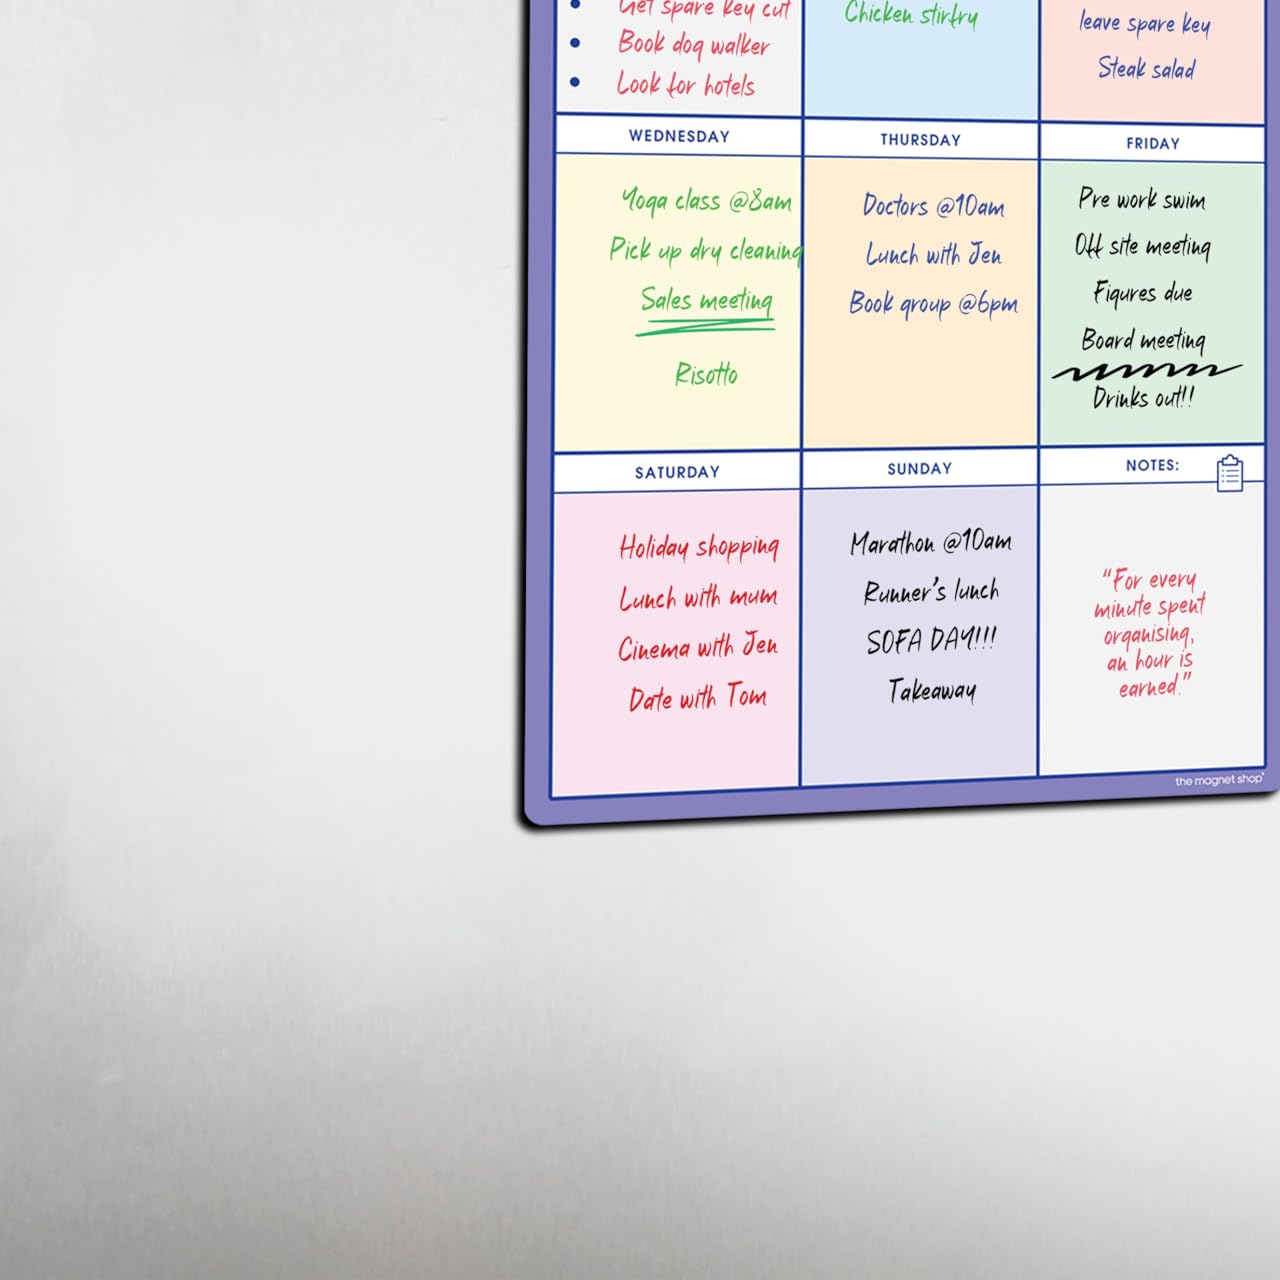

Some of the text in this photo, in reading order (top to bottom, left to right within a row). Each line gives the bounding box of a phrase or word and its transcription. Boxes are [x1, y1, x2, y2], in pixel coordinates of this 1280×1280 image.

[919, 2, 979, 33] stirfry
[1079, 8, 1212, 40] leave spare key
[618, 28, 772, 64] Book dog walker
[1098, 55, 1197, 81] Steak salad
[616, 69, 756, 99] Look for hotels
[628, 129, 730, 143] WEDNESDAY
[880, 133, 961, 147] THURSDAY
[1126, 137, 1180, 150] FRIDAY
[622, 185, 792, 219] Yoga class @8am
[863, 191, 1005, 219] Doctors @10am
[1078, 185, 1206, 210] Pre work swim
[609, 235, 805, 269] Pick up dry cleaning
[866, 240, 1002, 266] Lunch with Jen
[1075, 232, 1212, 264] Off site meeting
[641, 286, 773, 318] Sales meeting
[849, 289, 1019, 322] Book group @6pm
[1093, 279, 1193, 311] Figures due
[1082, 326, 1206, 357] Board meeting
[675, 360, 739, 387] Risotto
[1093, 384, 1195, 409] Drinks out!!
[634, 465, 720, 479] SATURDAY
[887, 462, 953, 476] SUNDAY
[1126, 459, 1180, 472] NOTES:
[619, 532, 781, 565] Holiday shopping
[850, 527, 1013, 556] Marathon @10am
[954, 577, 1000, 603] lunch
[1149, 571, 1197, 593] every
[619, 583, 778, 612] Lunch with mum
[1094, 591, 1207, 623] minute spent
[618, 629, 779, 662] Cinema with Jen
[867, 625, 998, 655] SOFA DAY!!!
[1103, 623, 1195, 653] organising,
[1107, 648, 1193, 672] an hour is
[629, 680, 767, 713] Date with Tom
[889, 677, 977, 705] Takeaway
[1175, 777, 1193, 787] the
[1194, 775, 1236, 787] magnet
